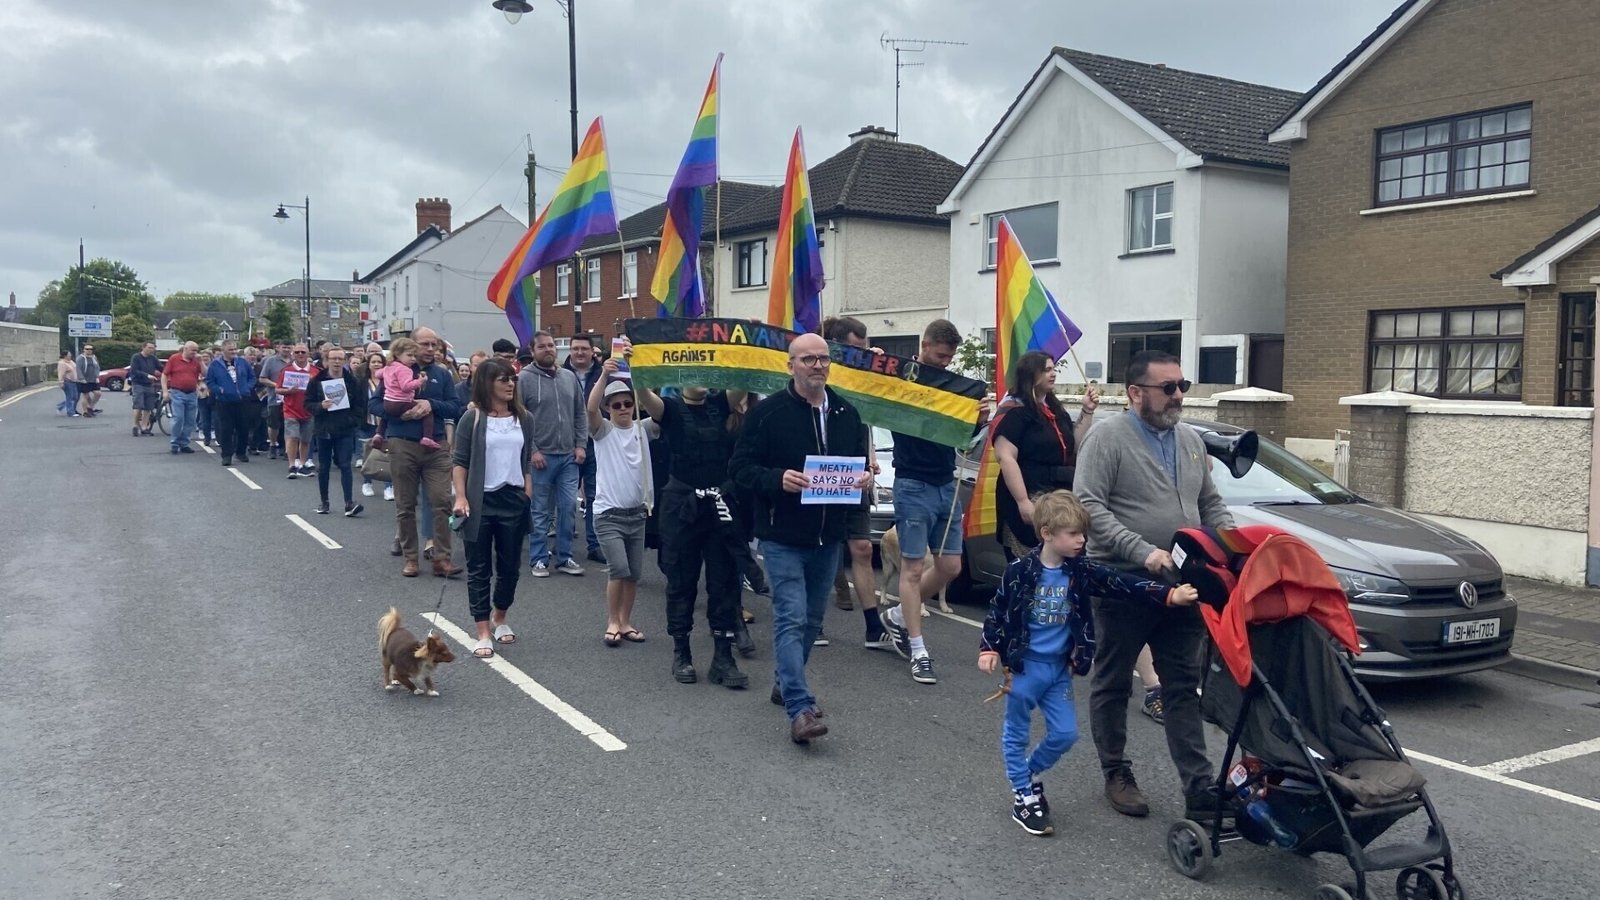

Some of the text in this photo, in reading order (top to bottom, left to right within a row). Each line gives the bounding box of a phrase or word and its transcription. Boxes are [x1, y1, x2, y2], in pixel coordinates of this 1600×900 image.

[662, 347, 715, 363] AGAINST
[819, 464, 853, 473] MEATH
[812, 475, 855, 486] SAYS NO
[811, 487, 851, 496] TO HATE
[1453, 622, 1495, 640] 191-MH-1703
